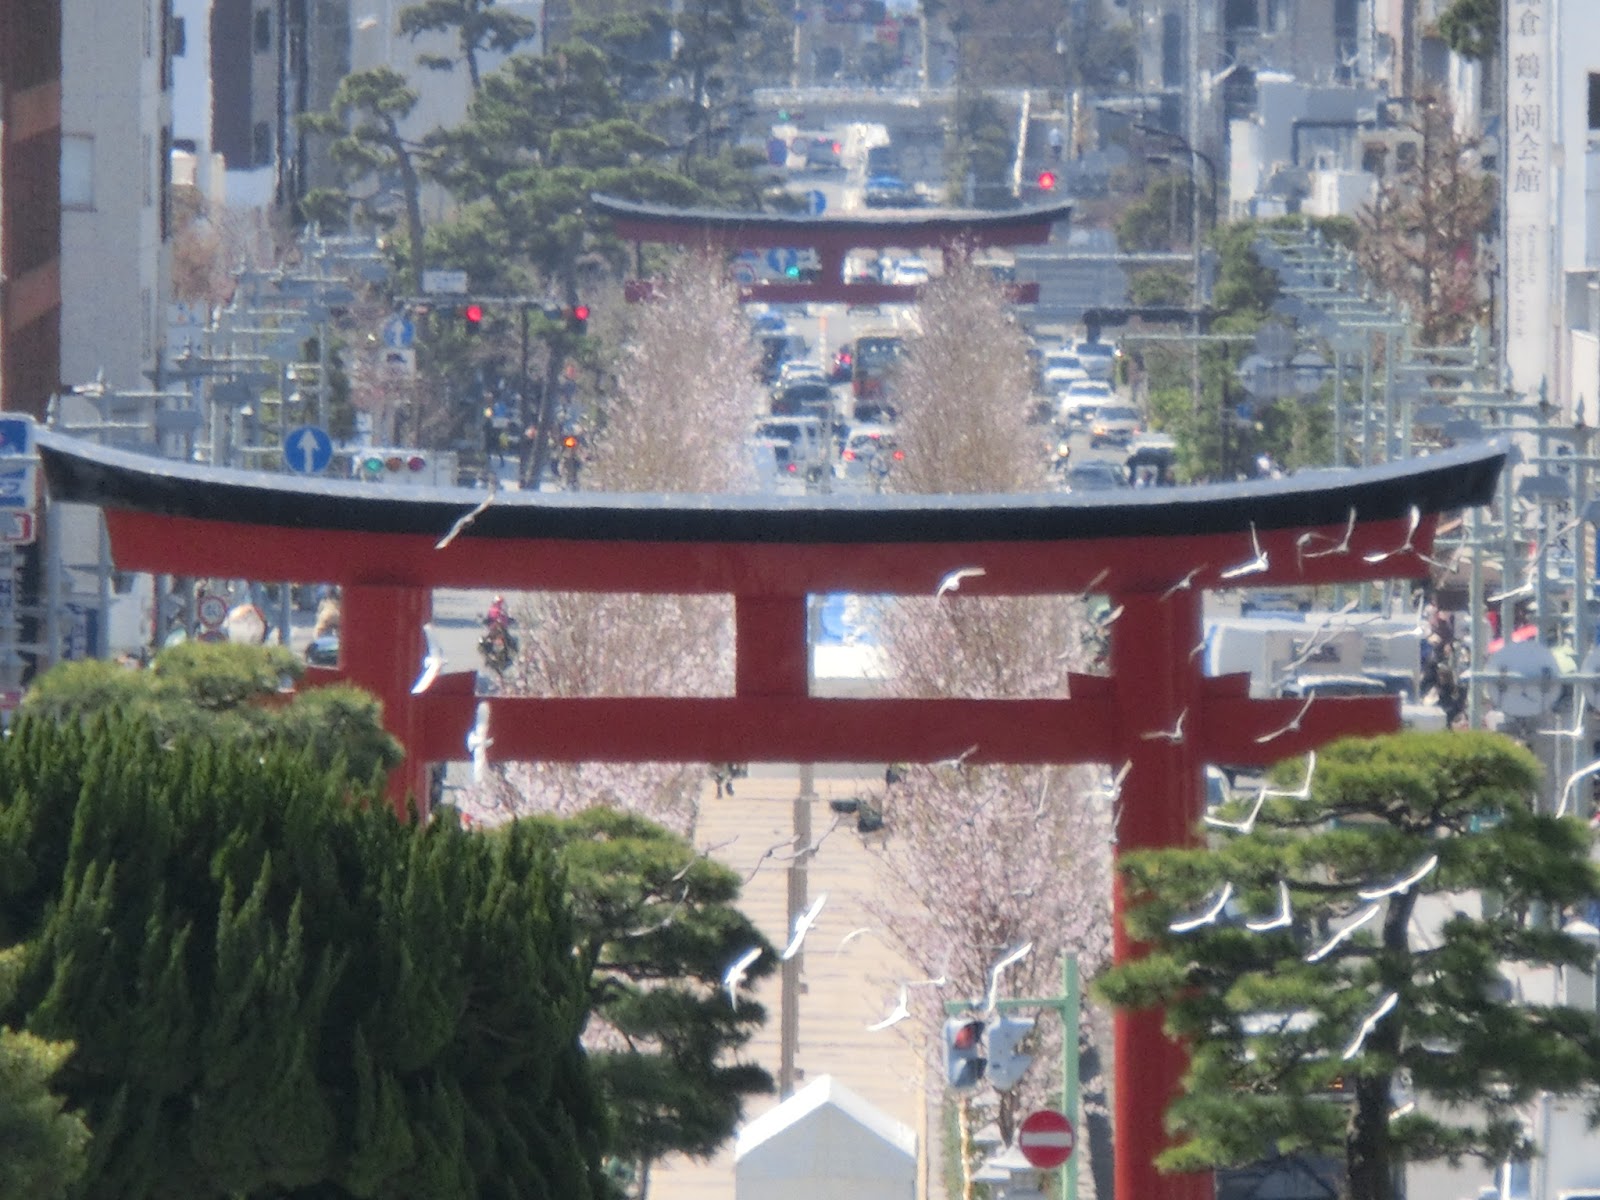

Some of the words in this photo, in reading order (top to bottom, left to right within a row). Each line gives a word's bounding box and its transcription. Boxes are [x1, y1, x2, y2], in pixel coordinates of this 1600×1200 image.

[1514, 0, 1542, 193] 倉鶴ヶ岡会館
